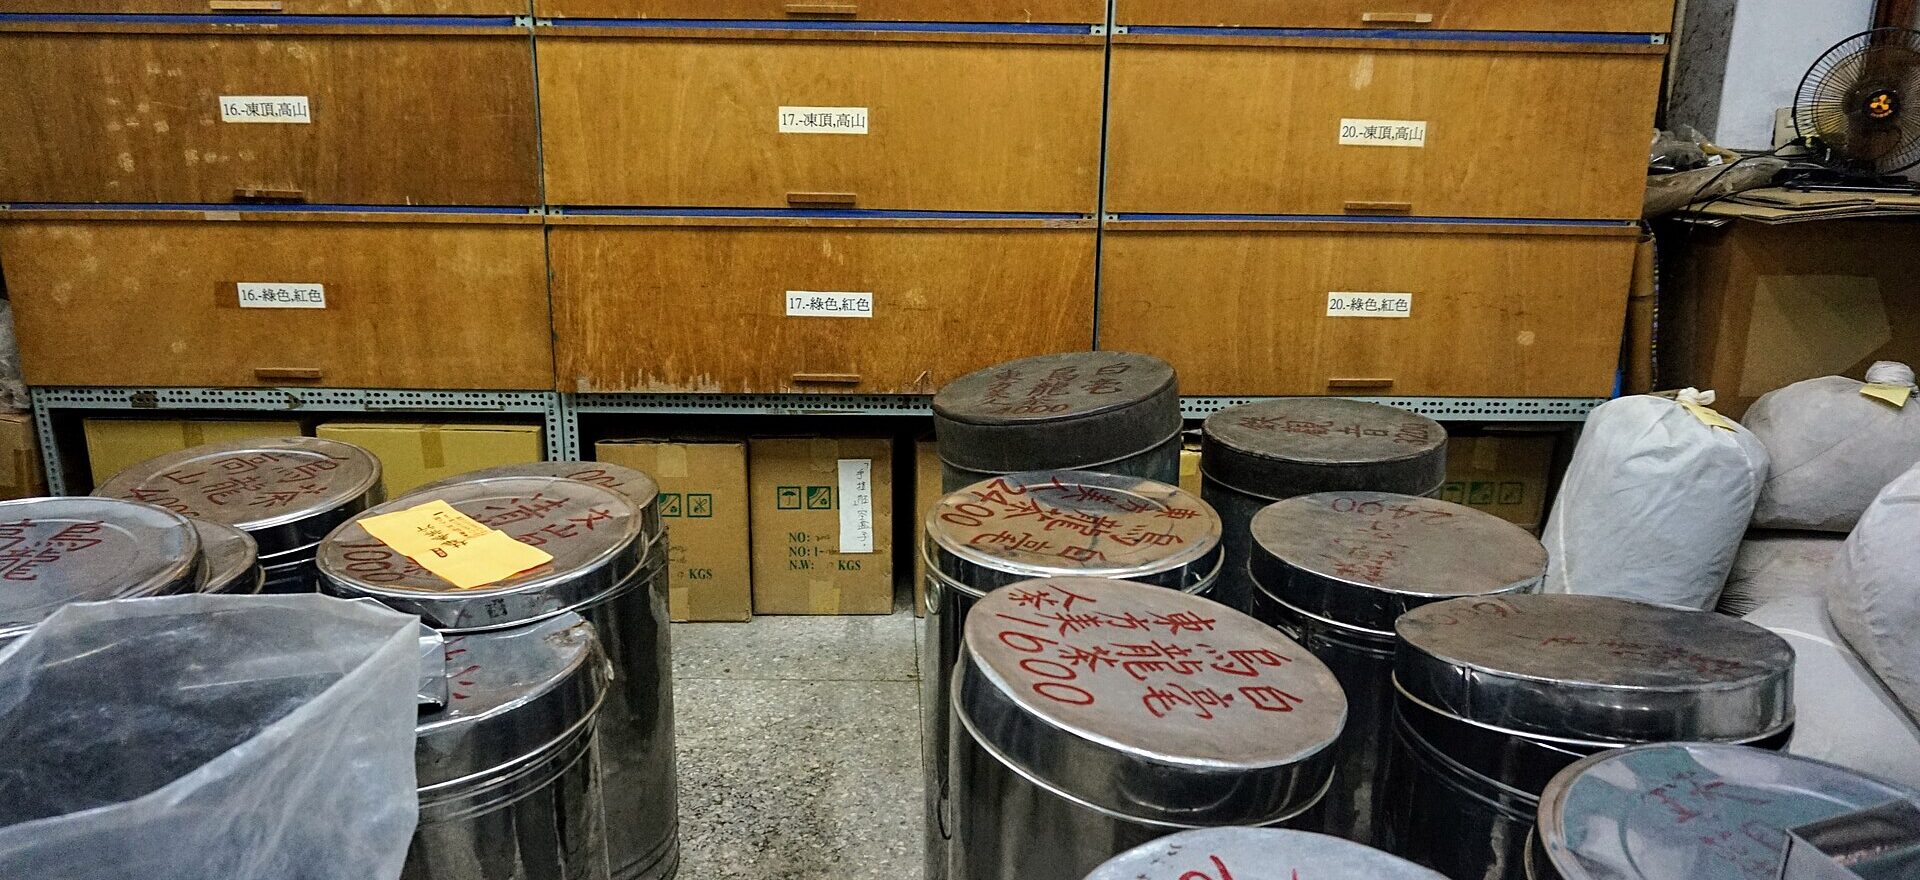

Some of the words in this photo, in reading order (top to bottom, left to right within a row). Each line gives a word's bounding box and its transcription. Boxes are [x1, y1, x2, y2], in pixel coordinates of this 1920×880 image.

[781, 112, 866, 129] 17.-凍頂,高山
[1341, 124, 1424, 142] 20.-凍頂,高山
[788, 296, 871, 312] 17.-綠色,紅色
[1329, 297, 1409, 313] 20.-綠色,紅色
[940, 478, 1028, 528] 2400
[1002, 498, 1184, 548] 烏龍茶
[789, 532, 810, 543] NO:
[789, 546, 810, 557] NO:
[838, 560, 861, 571] KGS
[689, 568, 713, 580] KGS
[995, 613, 1095, 707] 1600
[1057, 641, 1293, 682] 烏龍茶
